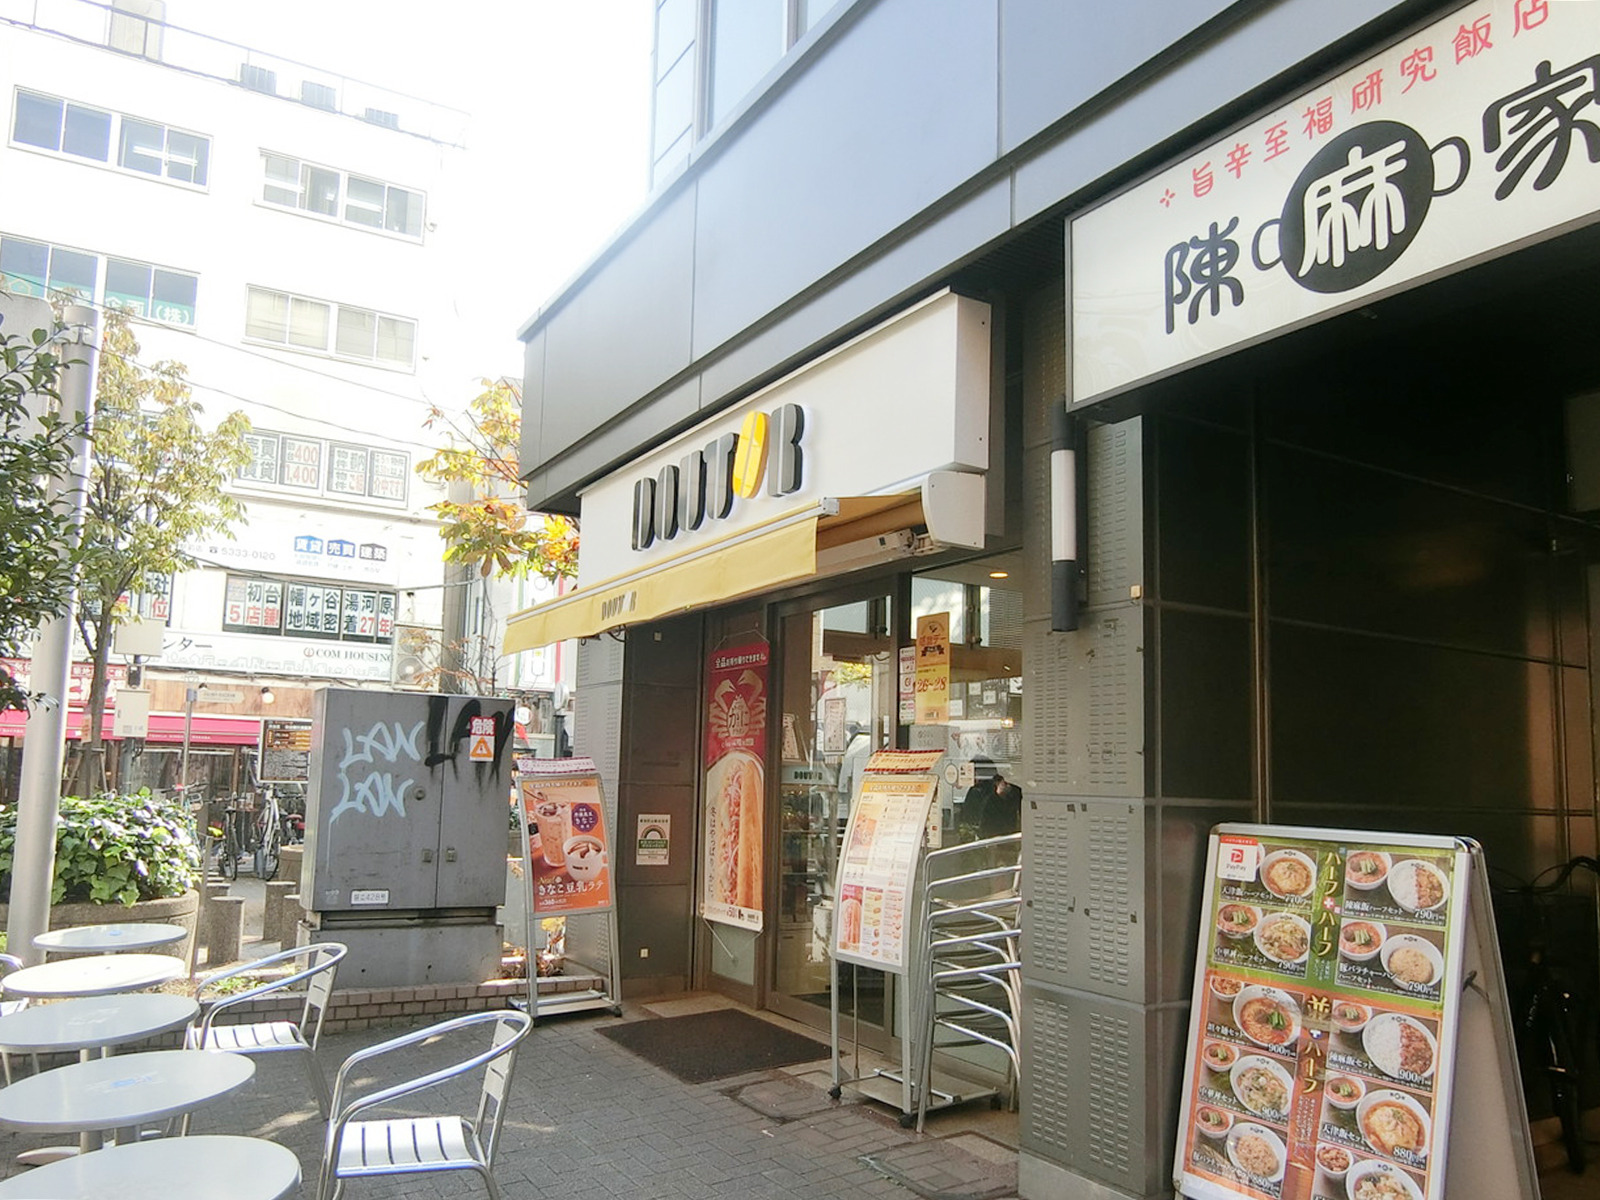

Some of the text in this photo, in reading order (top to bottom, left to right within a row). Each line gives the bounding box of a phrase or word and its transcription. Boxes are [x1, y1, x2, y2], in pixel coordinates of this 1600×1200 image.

[631, 403, 805, 551] DOUTOR
[247, 582, 280, 605] 初台
[315, 650, 344, 661] COM
[471, 718, 496, 735] 危険
[1226, 863, 1247, 872] PayPay
[1324, 852, 1342, 895] ハーフ
[1318, 911, 1335, 957] ハーフ
